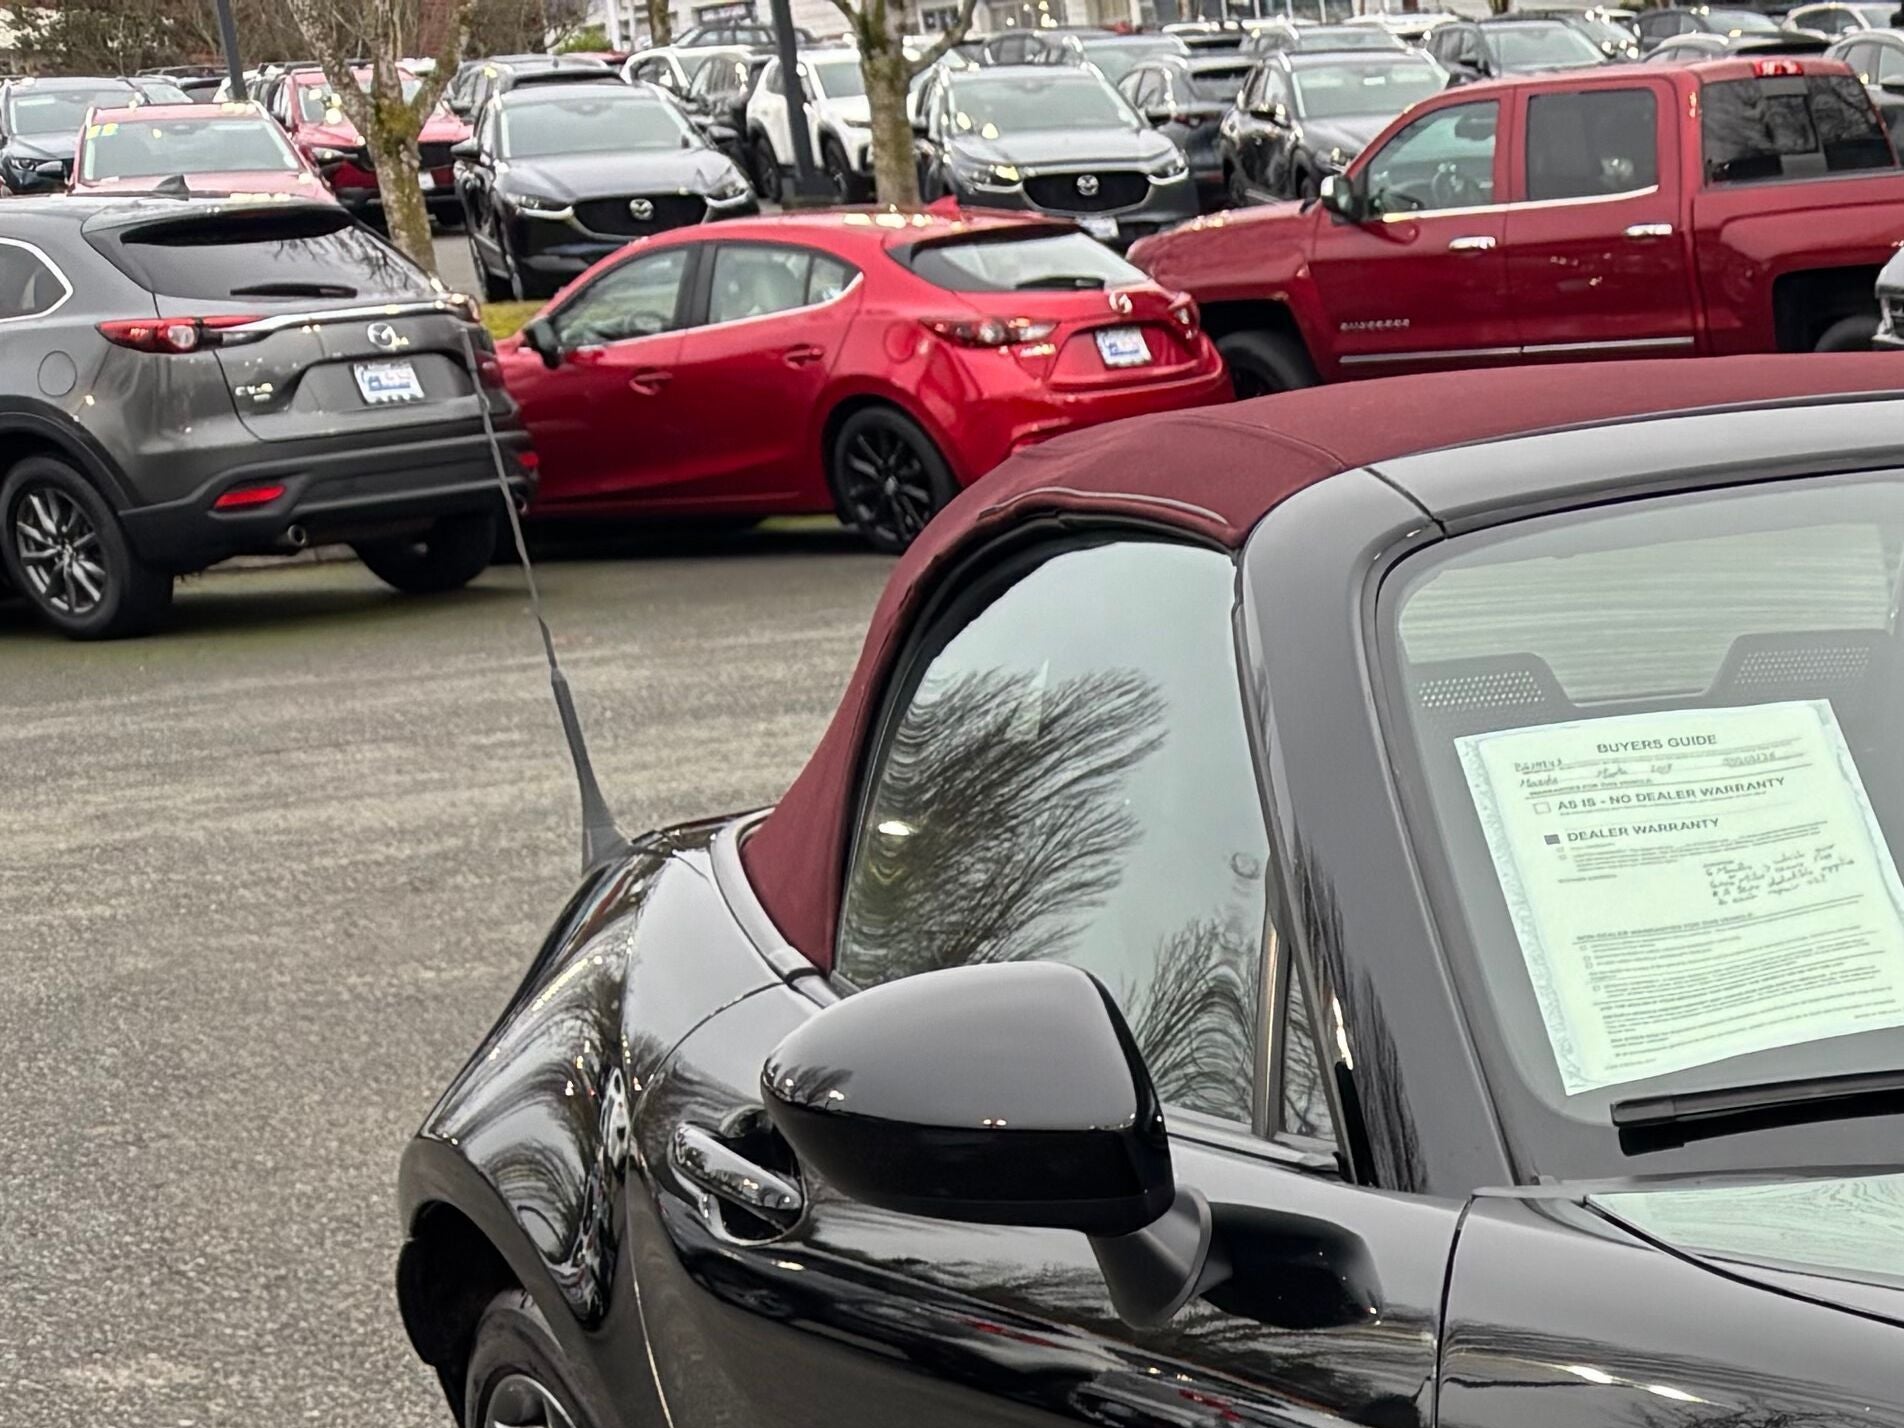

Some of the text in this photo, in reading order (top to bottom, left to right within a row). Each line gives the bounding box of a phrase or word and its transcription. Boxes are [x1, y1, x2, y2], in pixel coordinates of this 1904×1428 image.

[1596, 734, 1718, 754] BUYERS GUIDE
[1609, 793, 1632, 806] NO
[1636, 788, 1696, 804] DEALER
[1700, 776, 1786, 799] WARRANTY
[1566, 817, 1720, 843] DEALER WARRANTY
